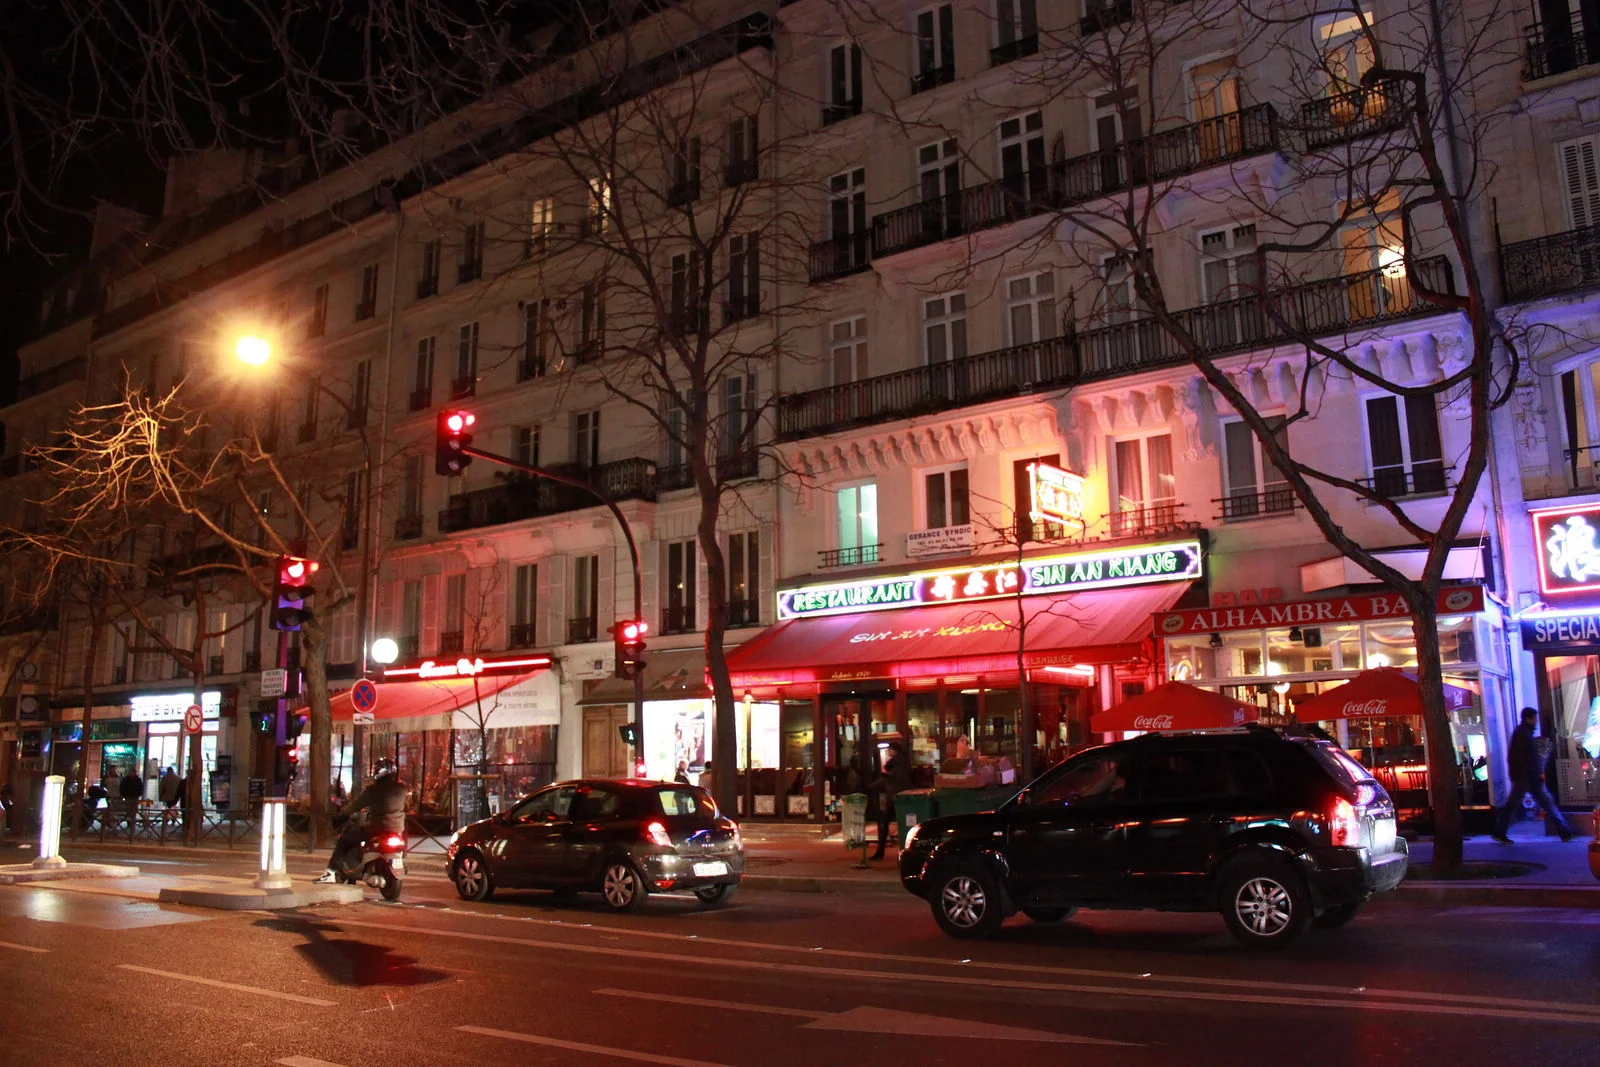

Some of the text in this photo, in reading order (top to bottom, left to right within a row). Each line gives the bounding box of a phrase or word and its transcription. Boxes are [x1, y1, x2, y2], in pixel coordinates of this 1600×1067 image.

[1031, 552, 1177, 587] SIN AN KIANG
[793, 582, 913, 611] RESTAURANT
[1190, 599, 1357, 631] ALHAMBRA
[1369, 595, 1409, 616] BA
